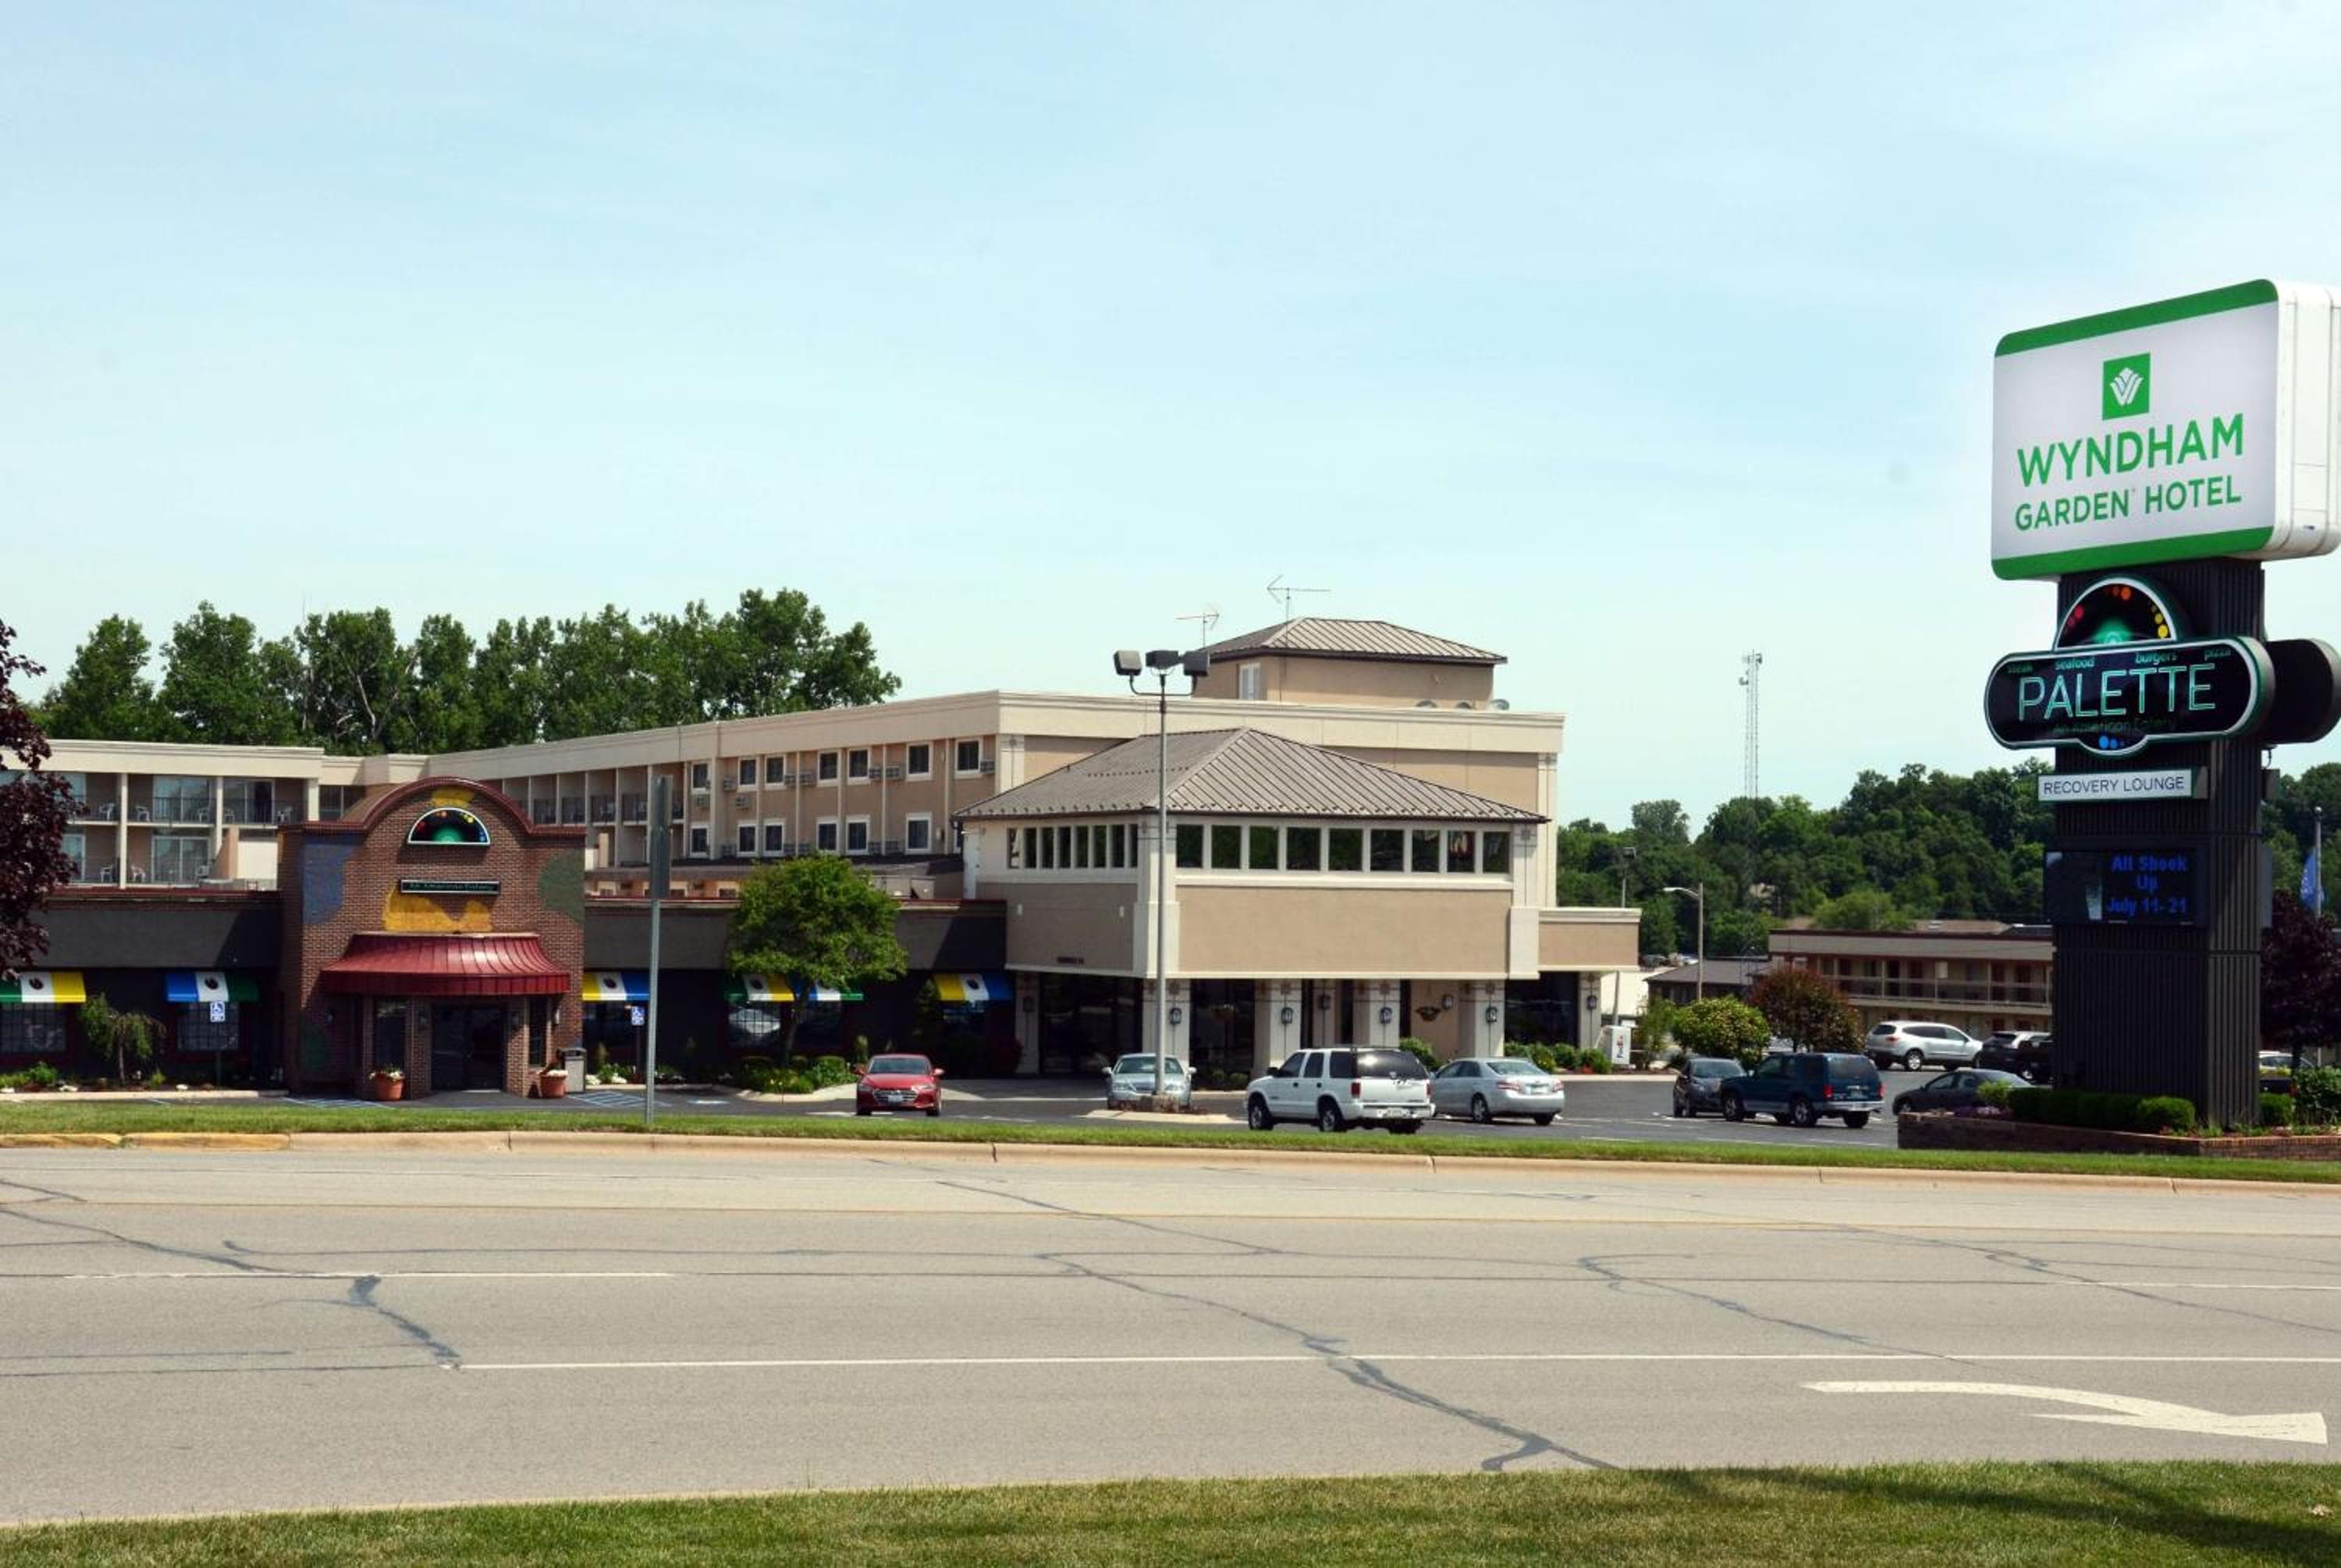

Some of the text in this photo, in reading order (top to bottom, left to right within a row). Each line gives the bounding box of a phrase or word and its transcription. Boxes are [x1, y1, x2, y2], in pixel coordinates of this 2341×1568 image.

[2017, 413, 2243, 487] WYNDHAM
[2016, 475, 2242, 531] GARDEN HOTEL
[2018, 663, 2215, 722] PALETTE
[2043, 776, 2185, 795] RECOVERY LOUNGE
[2110, 853, 2133, 872] All
[2137, 873, 2159, 894] Up
